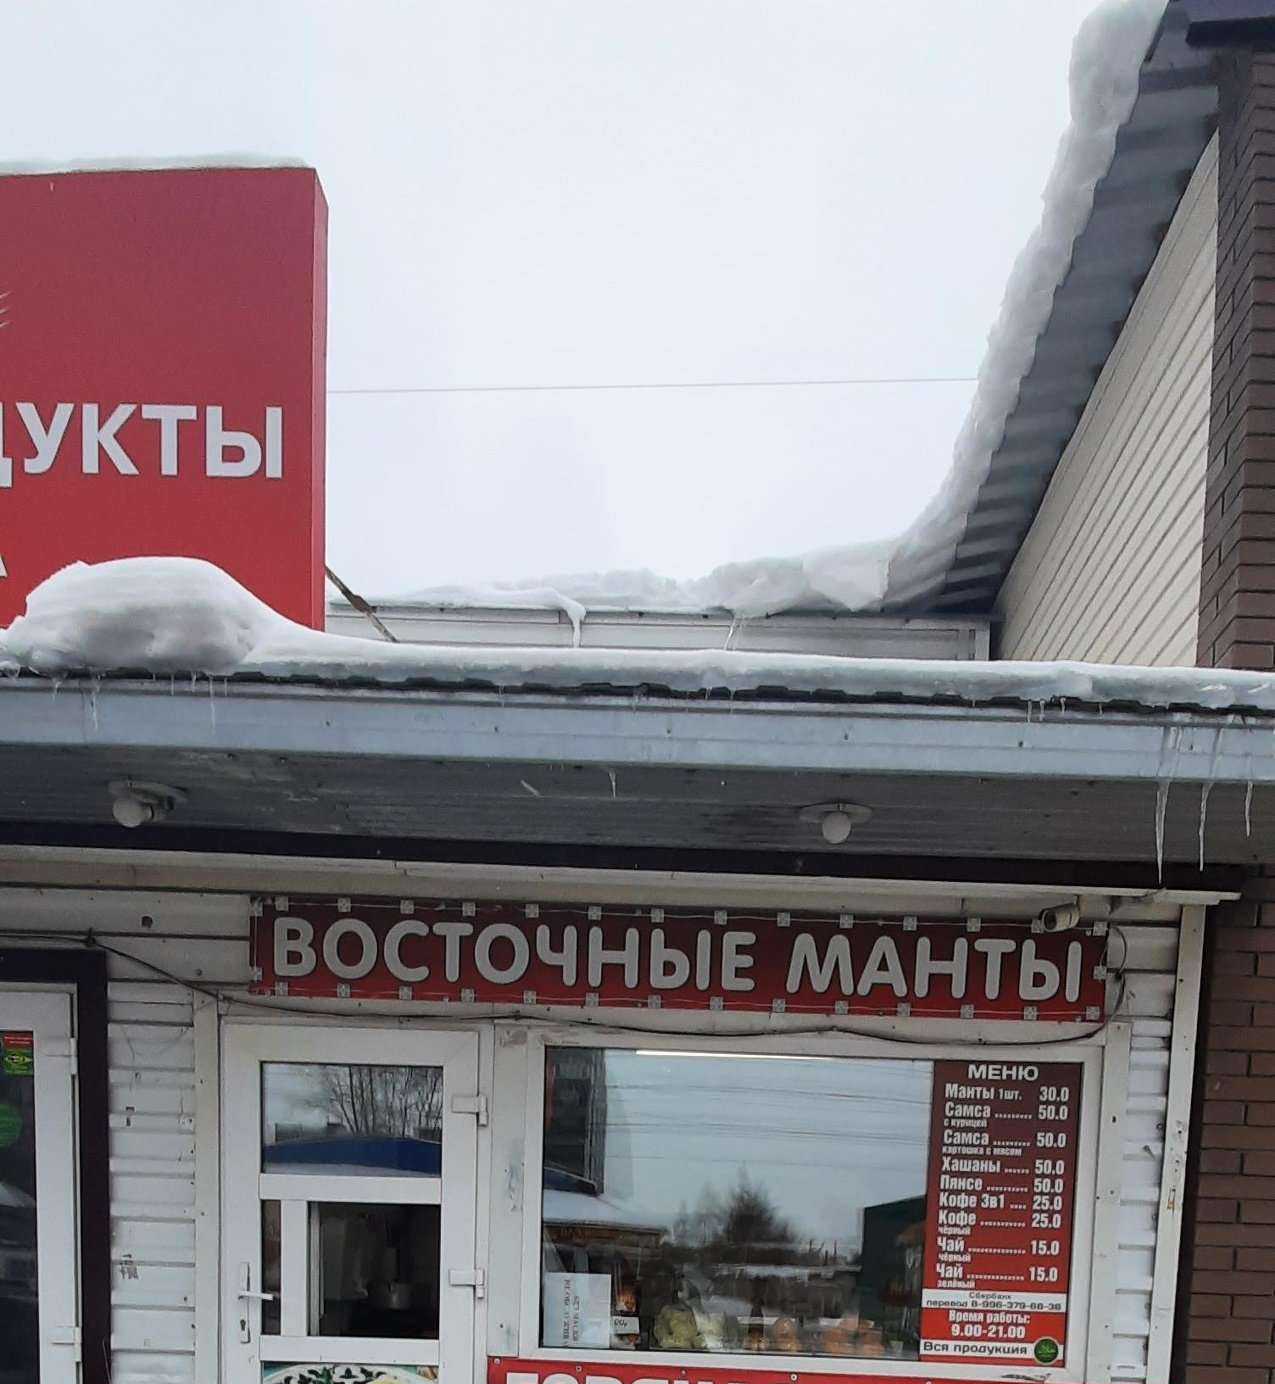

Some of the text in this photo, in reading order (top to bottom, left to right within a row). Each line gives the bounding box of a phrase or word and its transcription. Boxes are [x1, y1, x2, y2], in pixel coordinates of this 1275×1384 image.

[0, 402, 284, 488] УКТЫ
[273, 916, 1083, 1003] ВОСТОЧНЫЕ МАНТЫ
[967, 1064, 1039, 1081] МЕНЮ
[944, 1083, 995, 1100] Манты
[1039, 1086, 1069, 1102] 30.0
[944, 1101, 1069, 1121] Самса 50.0
[943, 1129, 1067, 1148] Самса 50.0
[941, 1156, 1065, 1175] Хашаны 50.0
[1033, 1178, 1064, 1193] 50.0
[939, 1192, 978, 1210] Кофе
[1032, 1195, 1063, 1211] 25.0
[938, 1209, 1062, 1229] Кофе 25.0
[936, 1236, 1060, 1256] Чай 15.0
[936, 1263, 1058, 1282] Чай 15.0
[948, 1310, 1031, 1325] Время работы:
[951, 1324, 1026, 1339] 9.00-21.00
[923, 1341, 1028, 1356] Вся продукция
